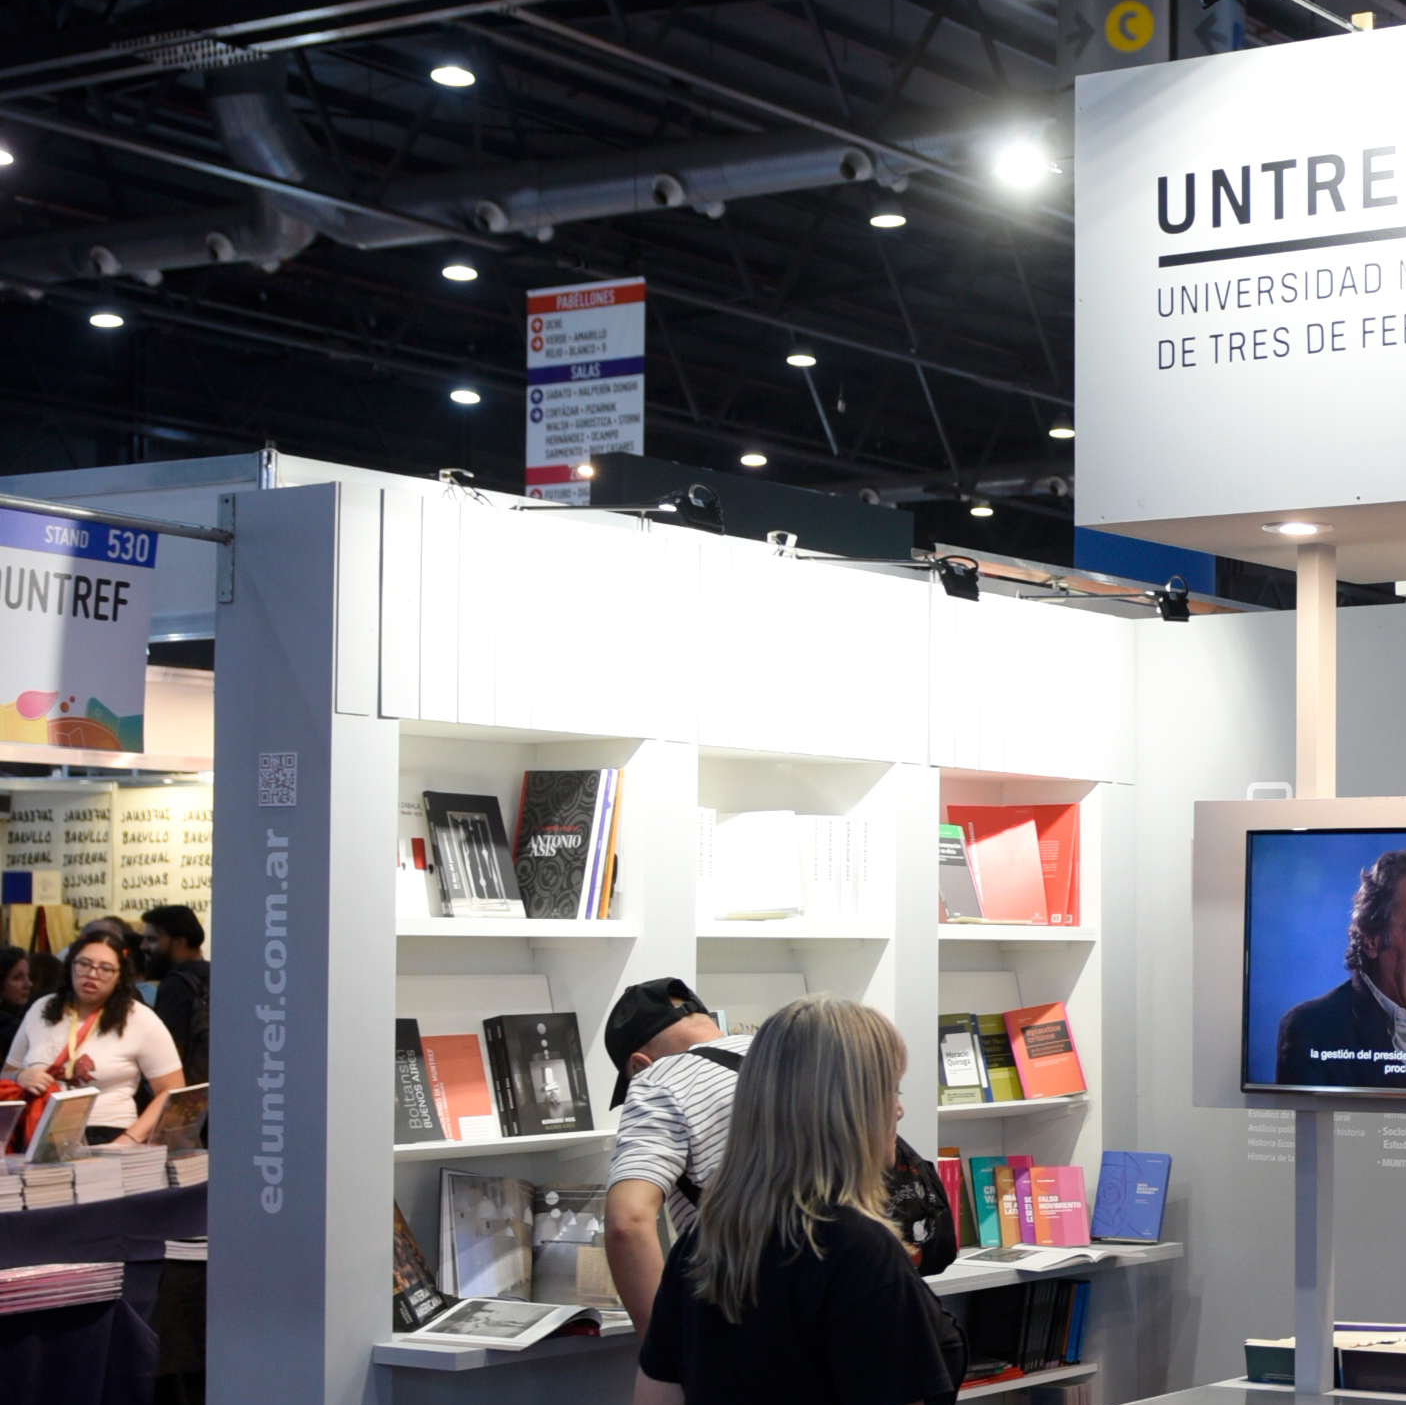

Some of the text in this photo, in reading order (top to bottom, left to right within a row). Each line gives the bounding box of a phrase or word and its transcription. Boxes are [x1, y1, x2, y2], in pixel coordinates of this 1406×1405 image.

[1119, 10, 1138, 41] C
[1157, 262, 1382, 318] UNIVERSIDAD
[556, 289, 616, 311] PABELLONES
[1157, 338, 1197, 371] DE
[1211, 328, 1290, 364] TRES
[1306, 321, 1347, 354] DE
[571, 363, 601, 381] SALAS
[45, 525, 150, 563] STAND 530
[0, 565, 131, 622] UNTREF
[527, 834, 582, 849] ANTONIO
[529, 845, 557, 857] ASIS
[254, 828, 289, 1214] eduntref.com.ar
[945, 1050, 970, 1058] Horacio
[947, 1058, 971, 1067] Quiroga
[1310, 1049, 1318, 1059] la
[1321, 1049, 1355, 1061] gestión
[1357, 1050, 1371, 1059] del
[426, 1048, 436, 1082] MUNTREF
[408, 1049, 434, 1129] BUENOS AIRES
[1337, 1128, 1365, 1137] historia
[1248, 1138, 1276, 1148] Historia
[1248, 1152, 1275, 1162] Historia
[1277, 1152, 1286, 1162] de
[1038, 1201, 1082, 1210] MOVIMIENTO
